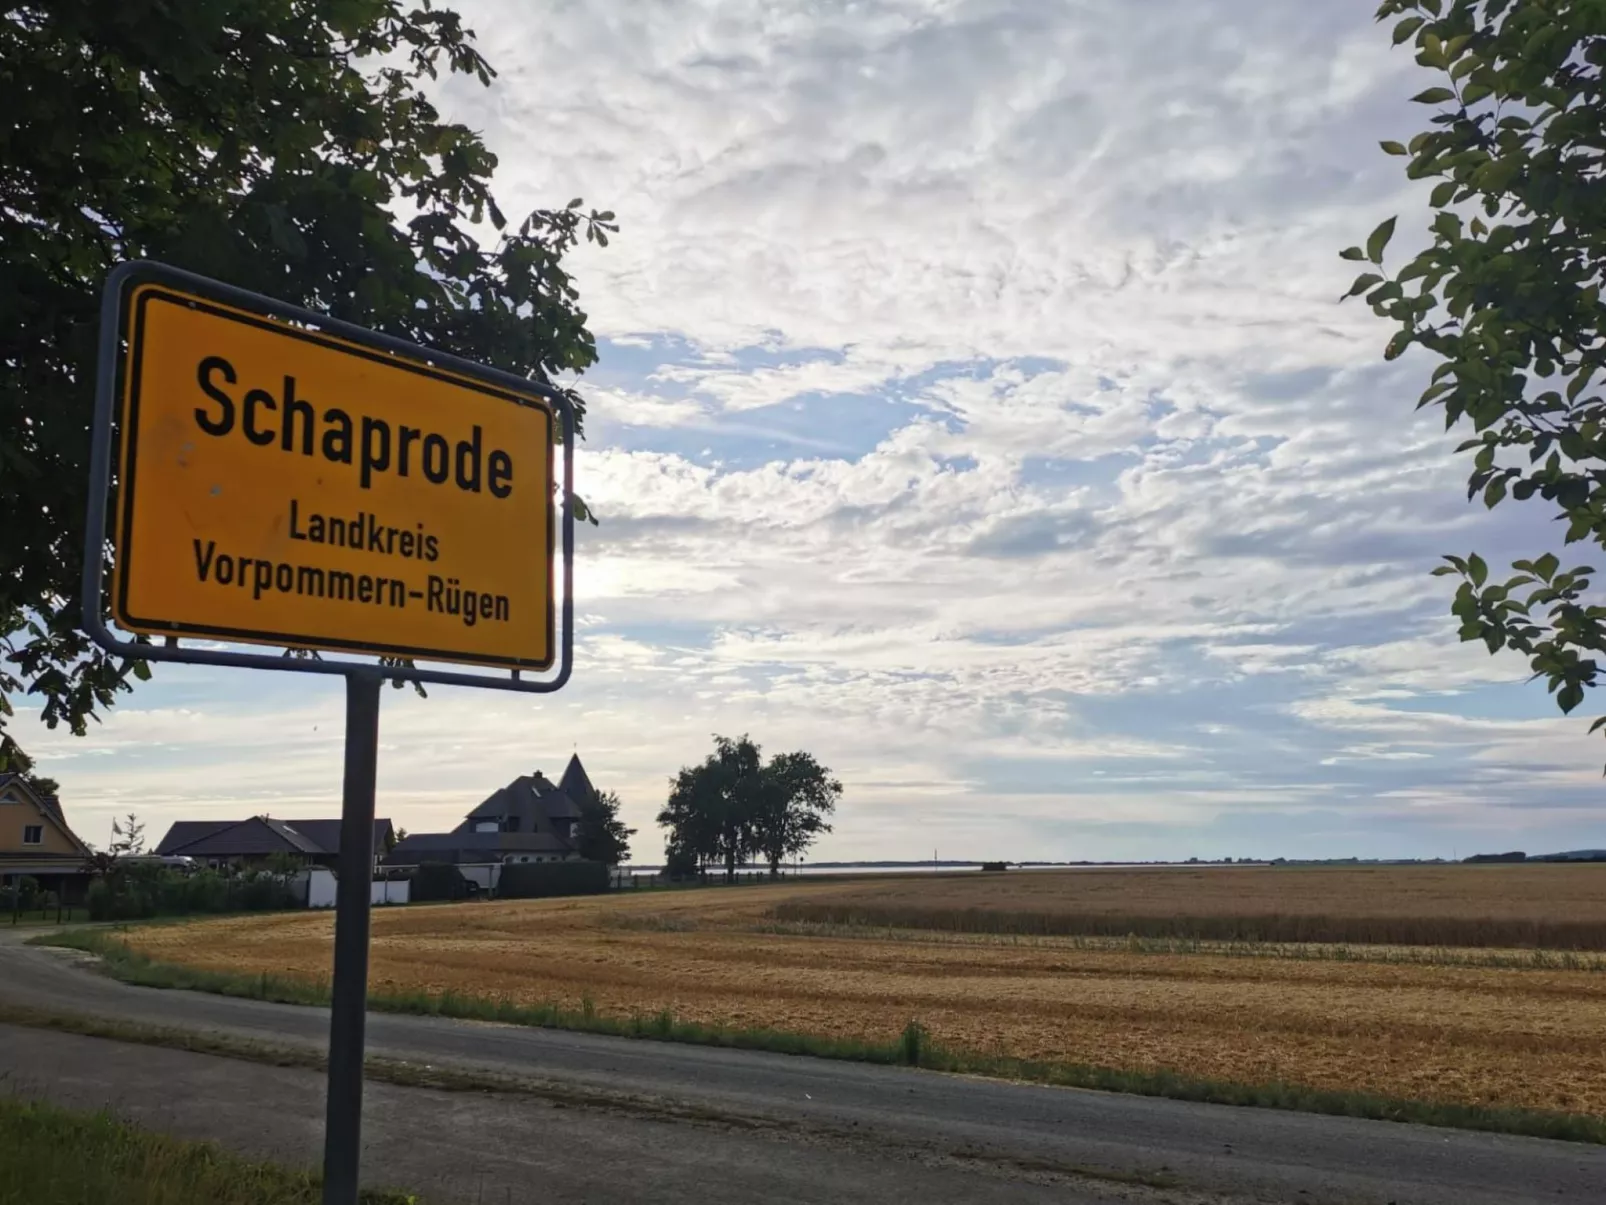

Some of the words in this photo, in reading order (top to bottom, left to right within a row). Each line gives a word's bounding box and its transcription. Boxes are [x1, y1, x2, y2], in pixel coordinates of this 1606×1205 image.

[193, 355, 514, 499] Schaprode
[289, 498, 440, 562] Landkreis
[192, 538, 510, 627] Vorpommern-Rügen
